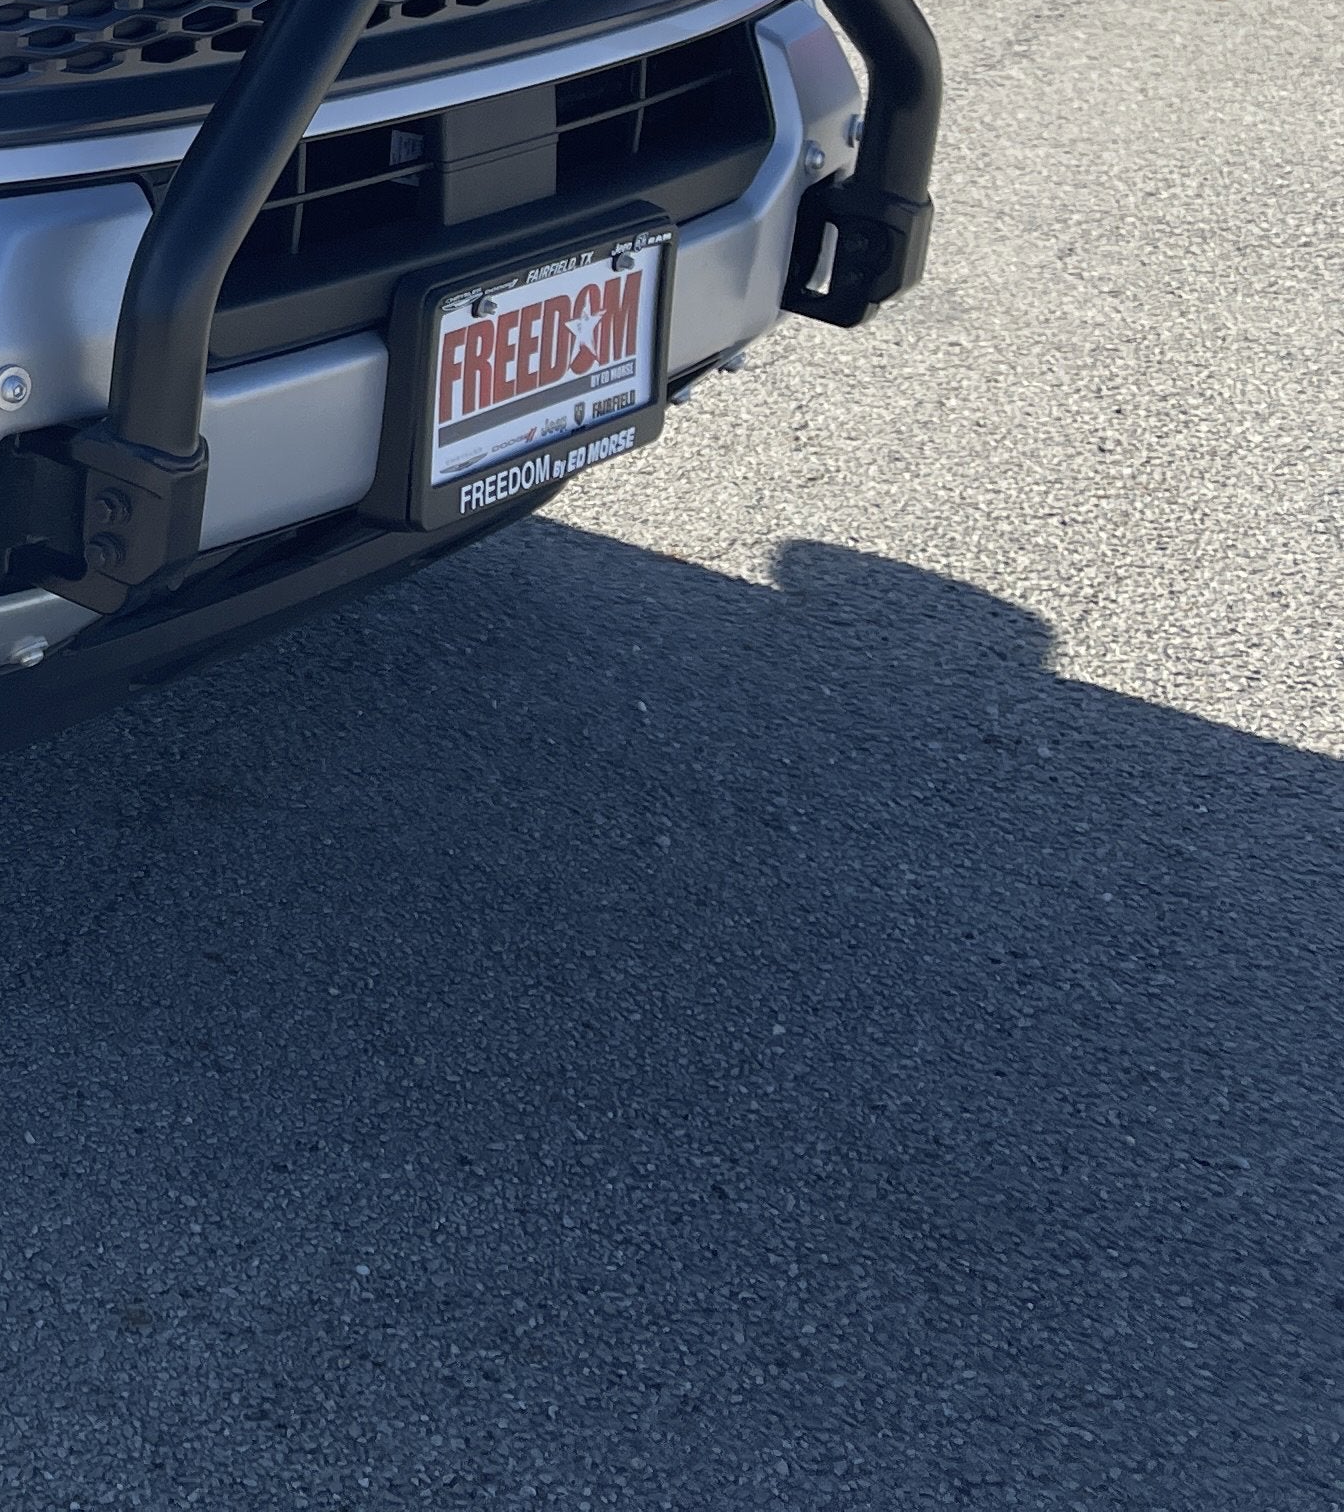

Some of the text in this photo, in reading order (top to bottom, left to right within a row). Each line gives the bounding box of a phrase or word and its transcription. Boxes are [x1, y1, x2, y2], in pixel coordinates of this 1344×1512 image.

[526, 255, 578, 284] FAIRFIELD,
[579, 251, 595, 266] TX
[438, 270, 643, 424] FREEDOM
[459, 454, 551, 514] FREEDOM
[566, 446, 587, 473] ED
[586, 427, 636, 465] MORSE
